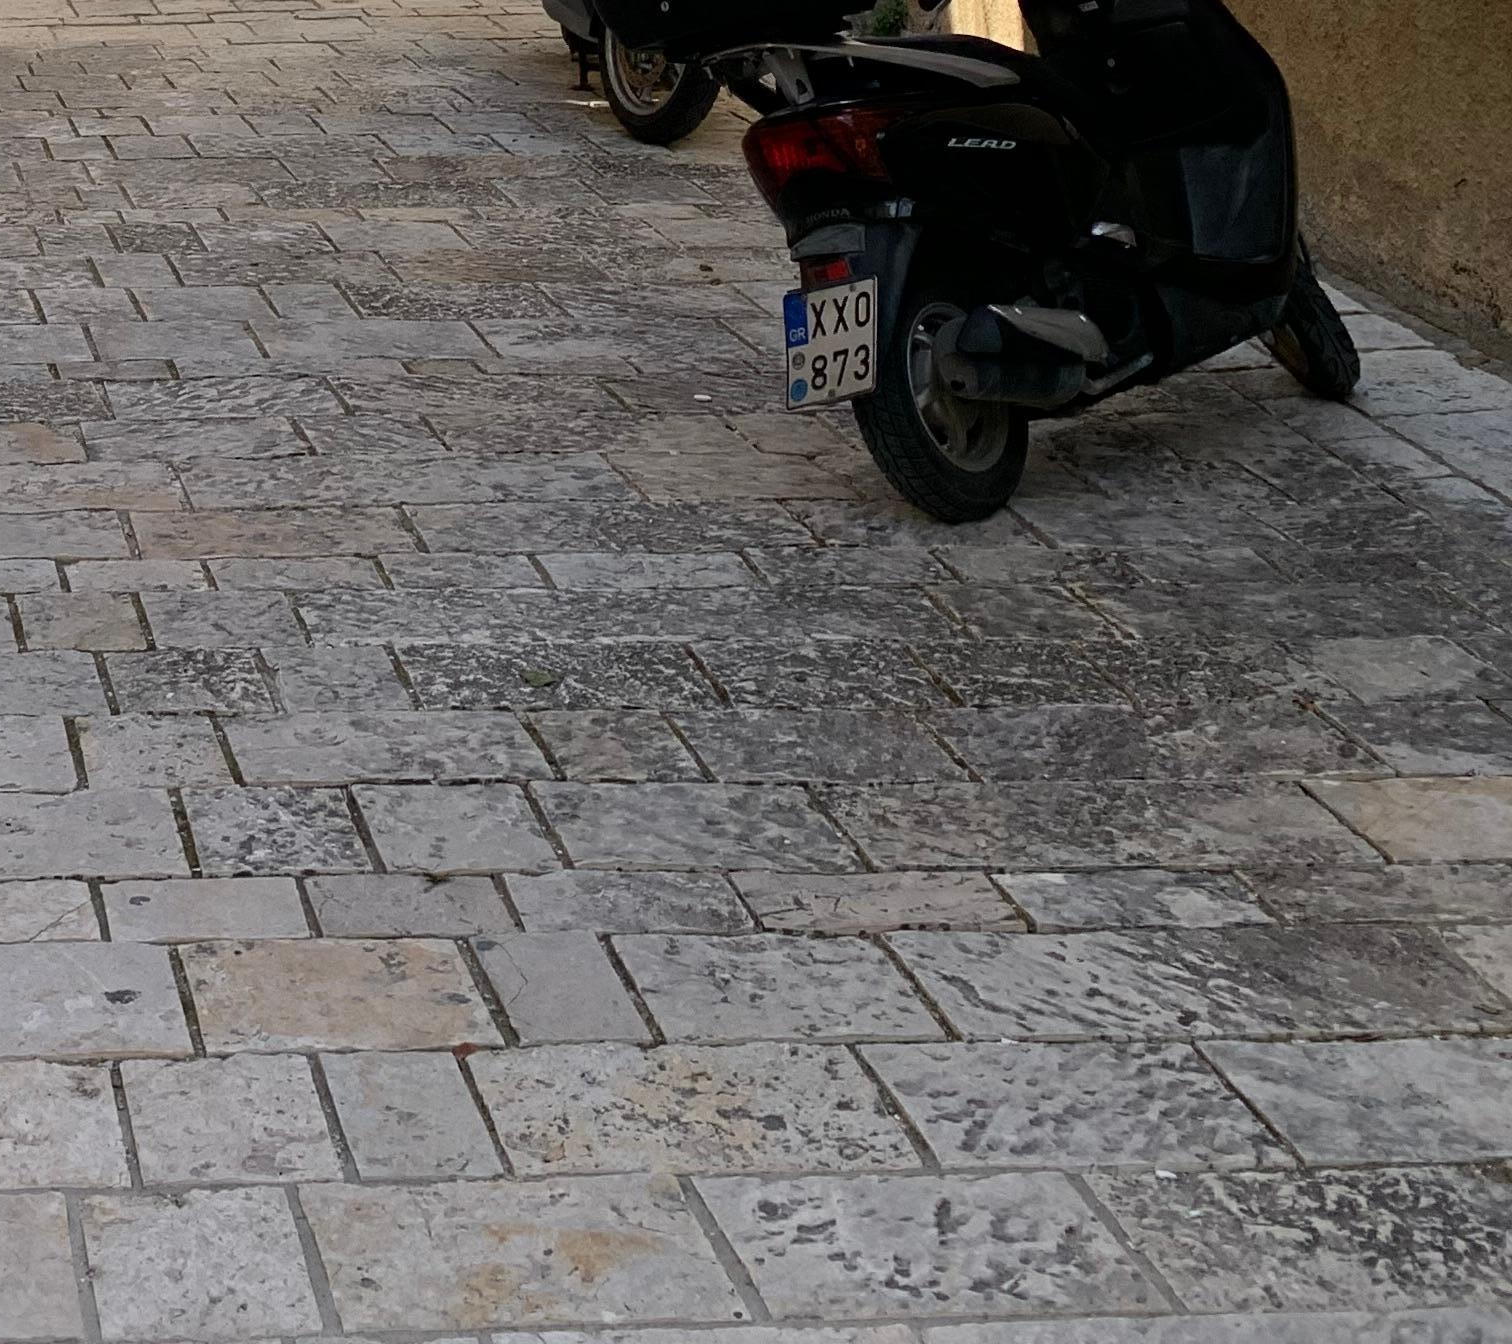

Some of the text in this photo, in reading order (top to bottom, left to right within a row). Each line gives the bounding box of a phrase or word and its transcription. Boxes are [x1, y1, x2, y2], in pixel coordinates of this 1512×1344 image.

[948, 138, 1017, 151] LEAD
[790, 327, 806, 342] GR
[811, 344, 870, 390] 873
